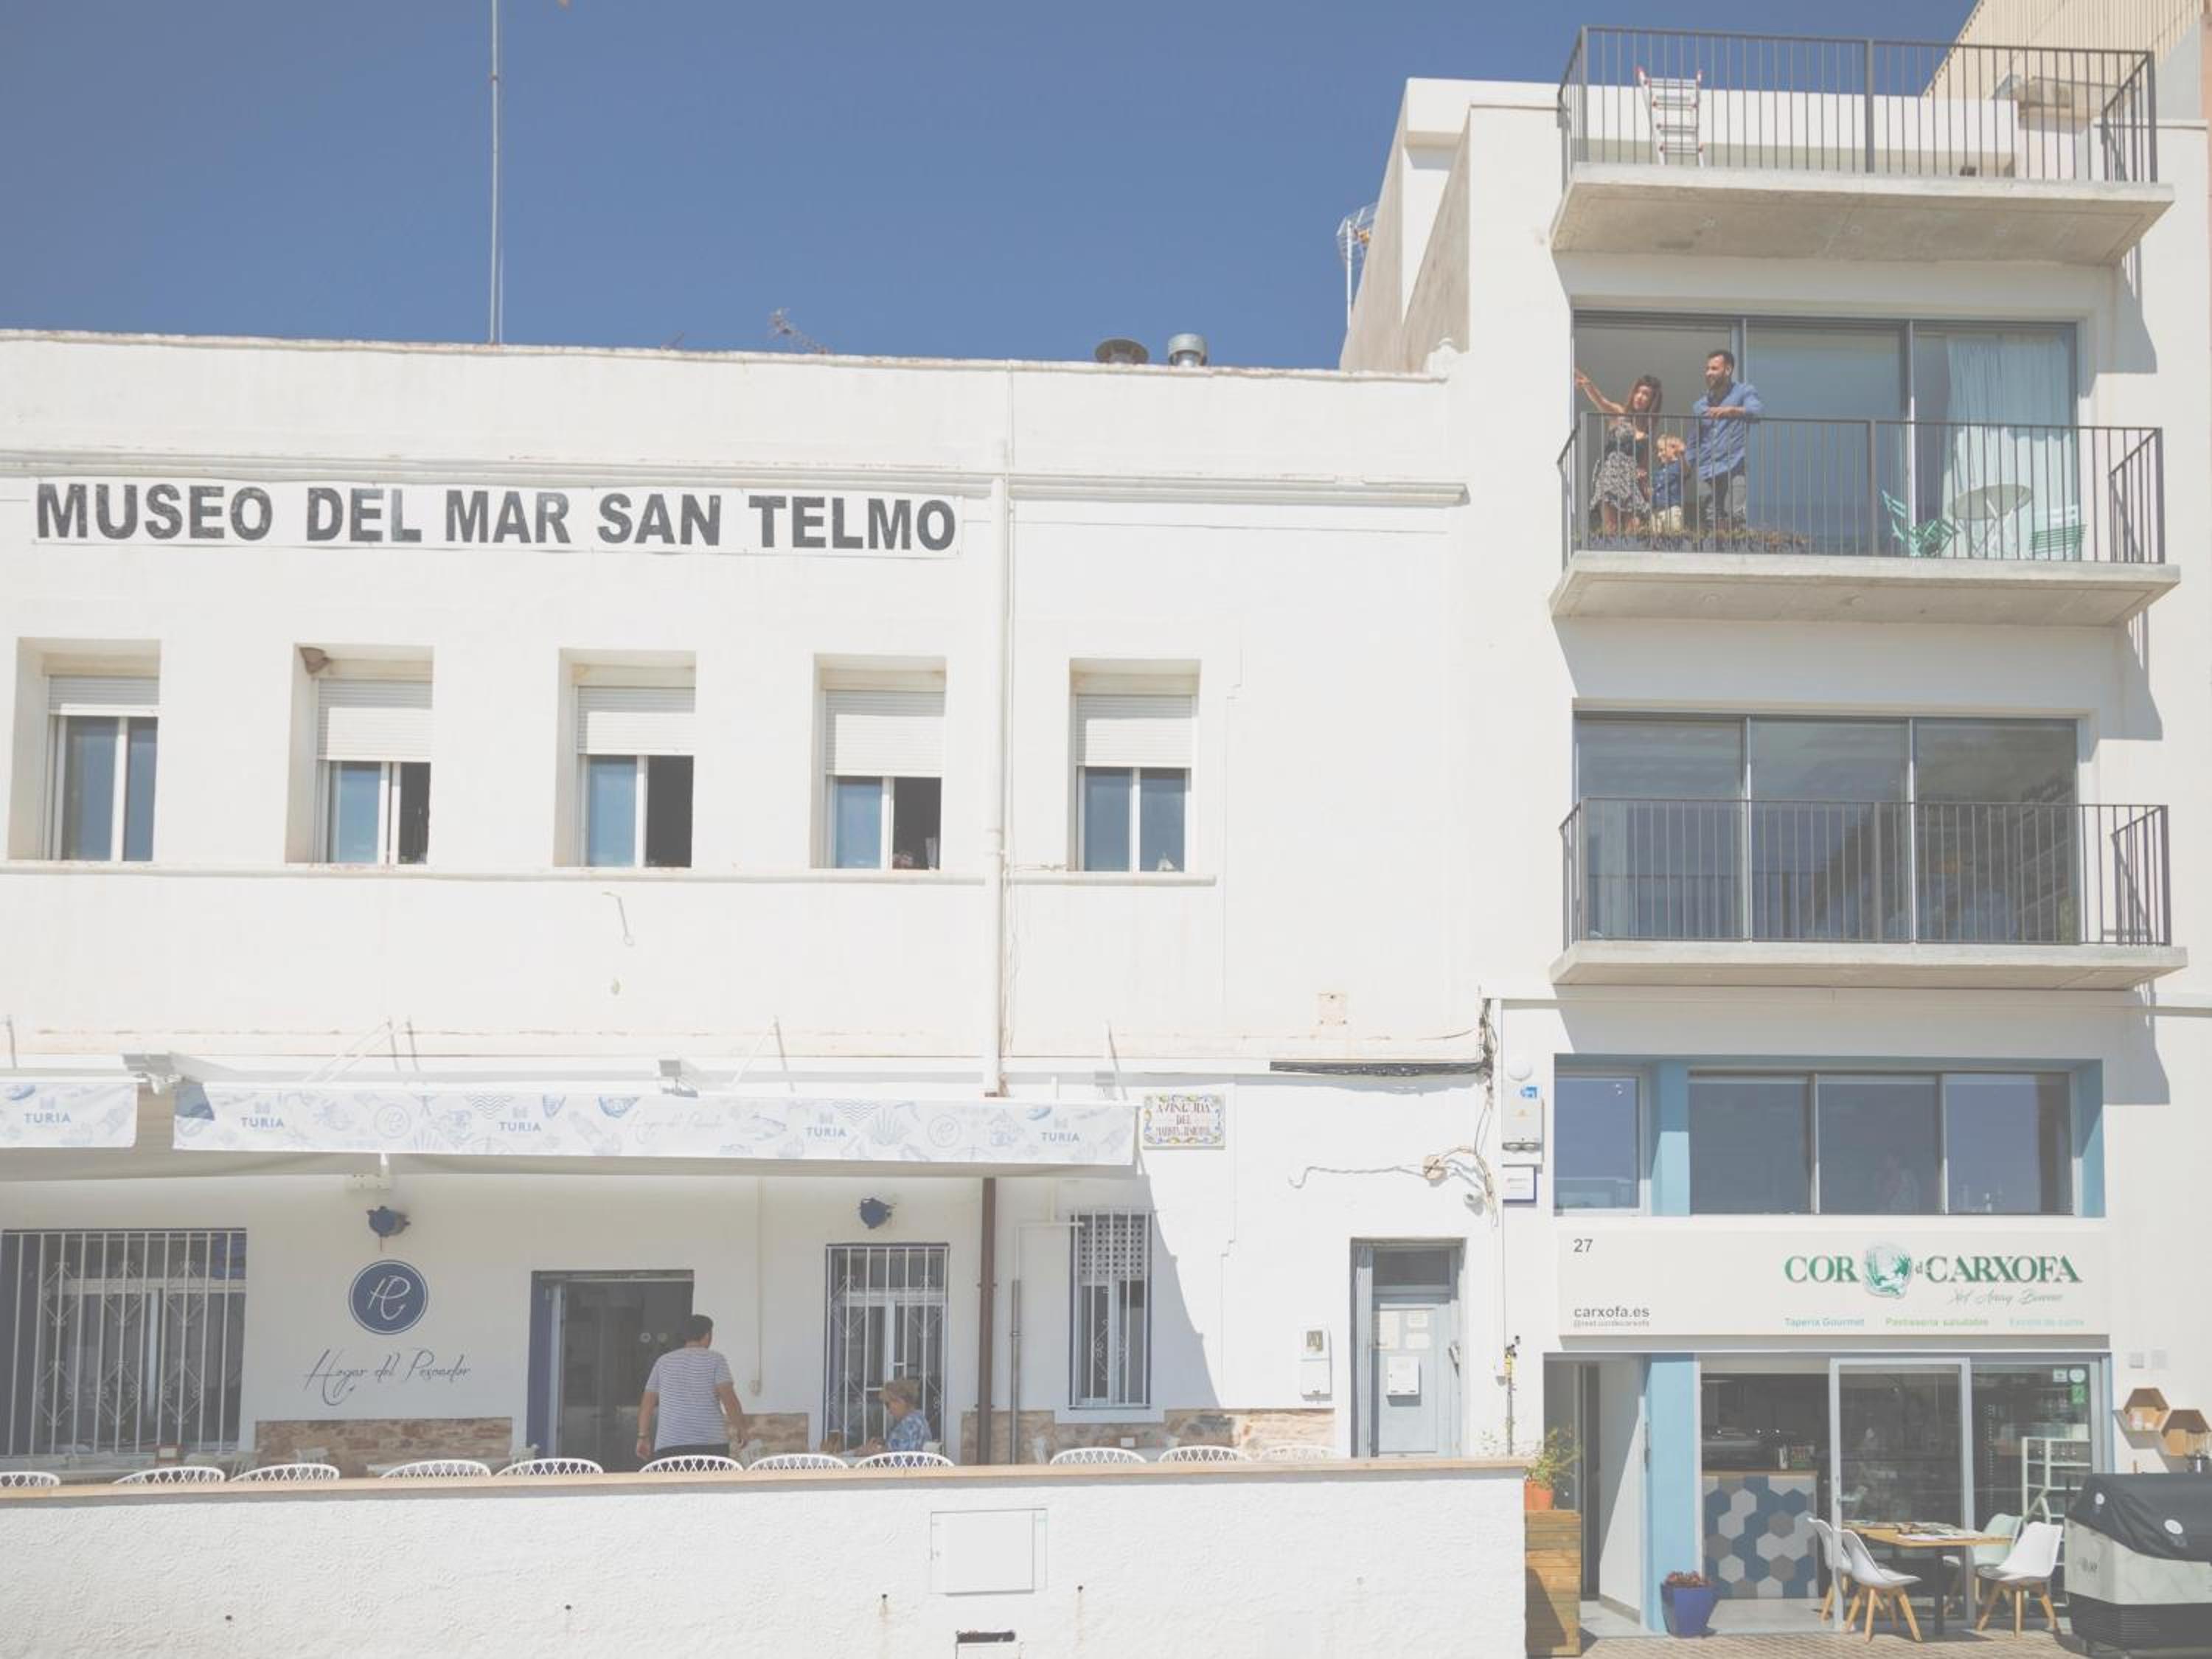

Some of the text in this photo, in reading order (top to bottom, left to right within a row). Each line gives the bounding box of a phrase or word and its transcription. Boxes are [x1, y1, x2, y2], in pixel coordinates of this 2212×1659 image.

[37, 483, 956, 552] MUSEO DEL MAR SAN TELMO
[24, 1113, 72, 1124] TURIA
[240, 1116, 285, 1129] TURIA
[498, 1121, 542, 1133] TURIA
[805, 1126, 848, 1138] TURIA
[1041, 1132, 1081, 1144] TURIA
[1573, 1238, 1593, 1253] 27
[1784, 1255, 1860, 1284] COR
[1925, 1255, 2083, 1284] CARXOFA
[1574, 1305, 1650, 1318] carxofa.es
[374, 1351, 401, 1383] del
